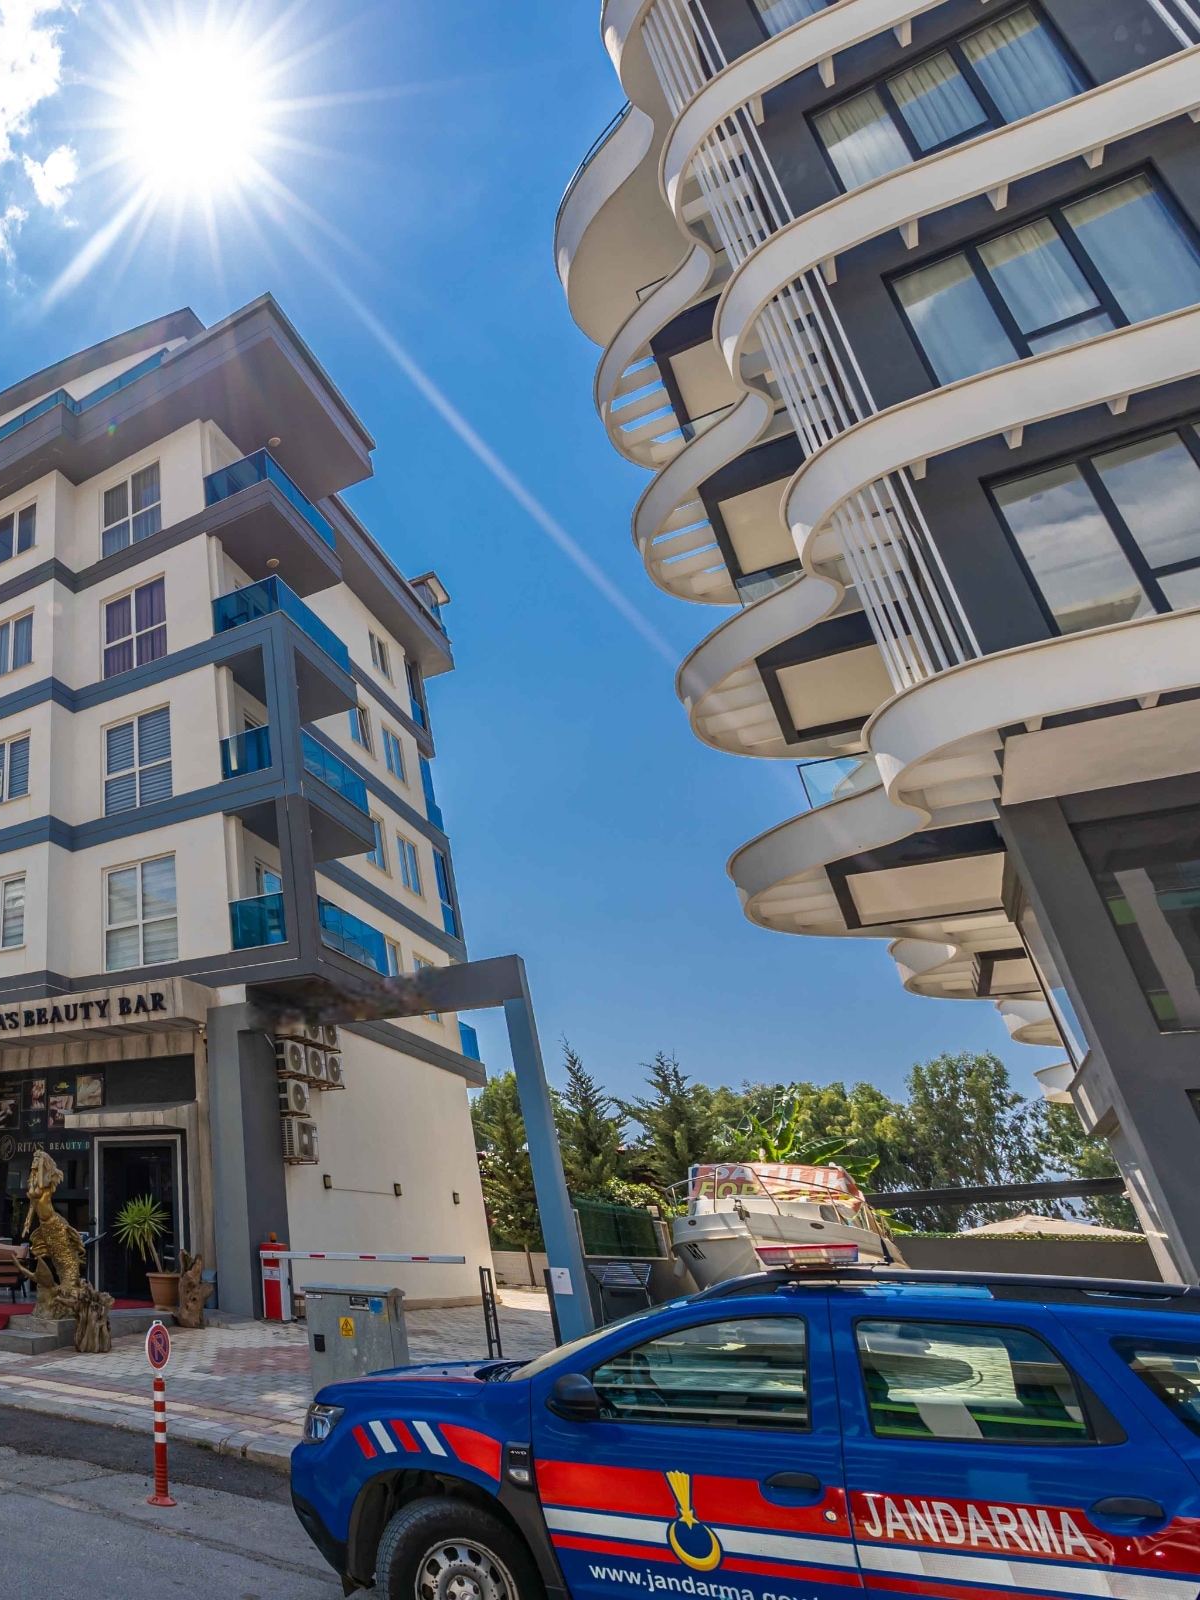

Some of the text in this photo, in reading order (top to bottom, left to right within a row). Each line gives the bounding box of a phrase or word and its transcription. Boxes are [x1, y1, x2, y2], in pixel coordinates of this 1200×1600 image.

[24, 999, 109, 1028] BEAUTY
[118, 992, 167, 1016] BAR
[49, 1142, 82, 1150] BEAUTY
[699, 1181, 760, 1199] FOR
[863, 1495, 1098, 1558] JANDARMA
